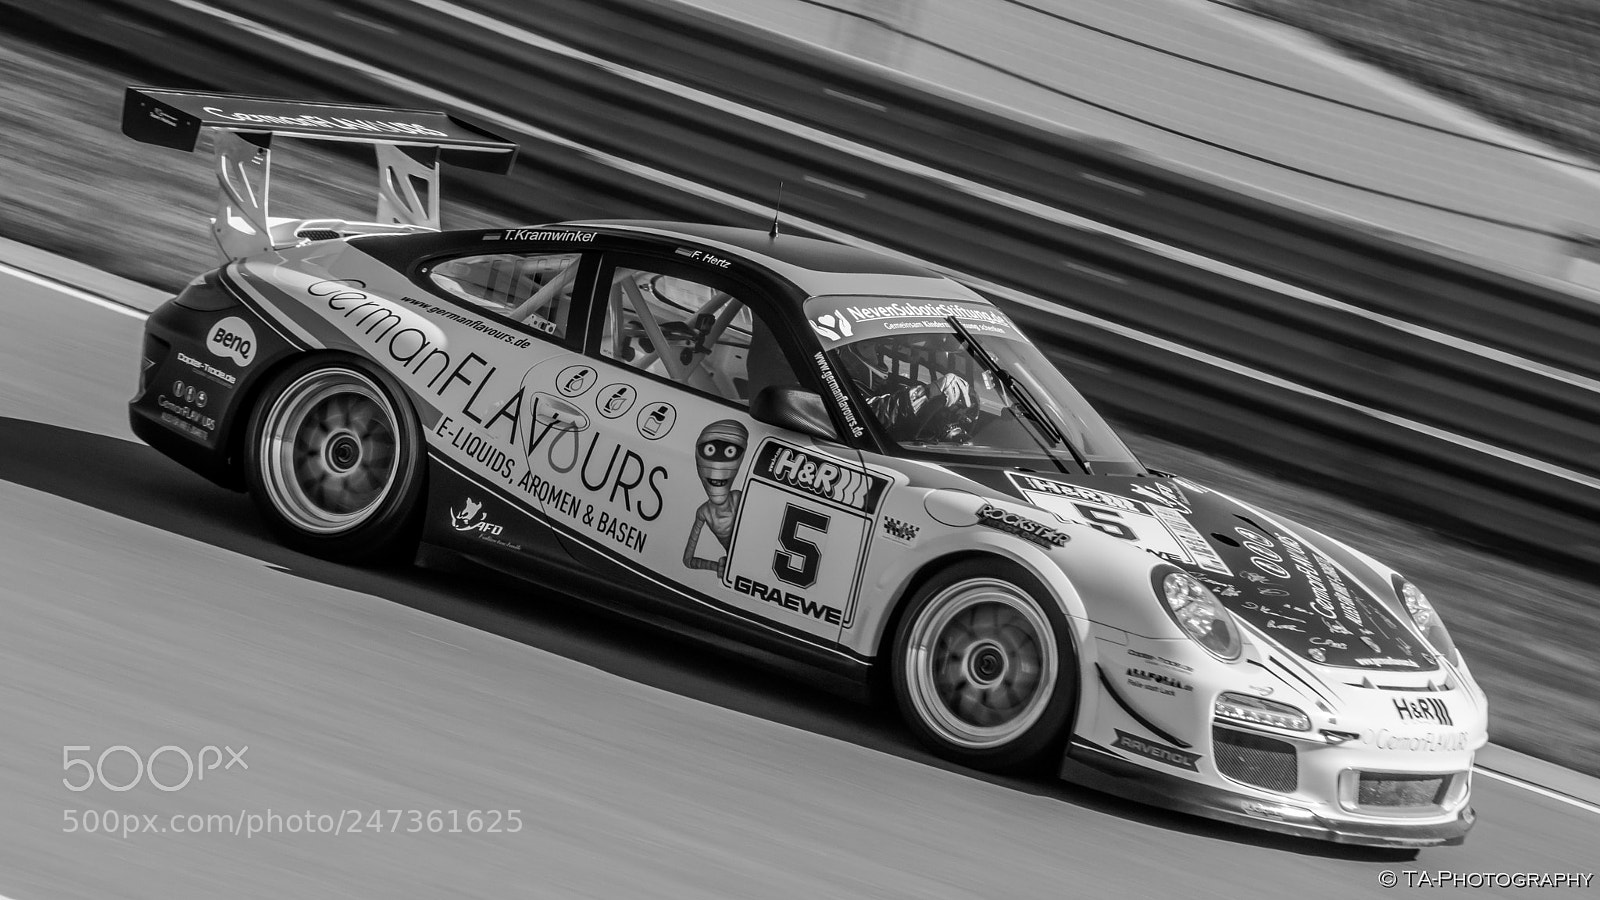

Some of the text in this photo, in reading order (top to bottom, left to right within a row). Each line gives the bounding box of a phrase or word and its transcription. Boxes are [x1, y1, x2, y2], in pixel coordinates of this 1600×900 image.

[503, 229, 598, 243] T.Kramwinkel
[690, 250, 732, 270] F. Hertz
[400, 294, 532, 350] www.germanflavours.de
[846, 302, 1008, 326] NevenSuboticStiftung.de
[212, 327, 252, 360] BenQ
[307, 278, 669, 522] GermanFLAVOURS
[813, 351, 863, 438] www.germanflavours.de
[436, 416, 648, 554] E-LIQUIDS, AROMEN & BASEN
[773, 449, 843, 499] H&R
[1071, 502, 1141, 542] 5
[771, 501, 832, 590] 5
[733, 574, 843, 627] GRAEWE
[1392, 697, 1436, 720] H&R
[1119, 735, 1194, 767] RAVENOL
